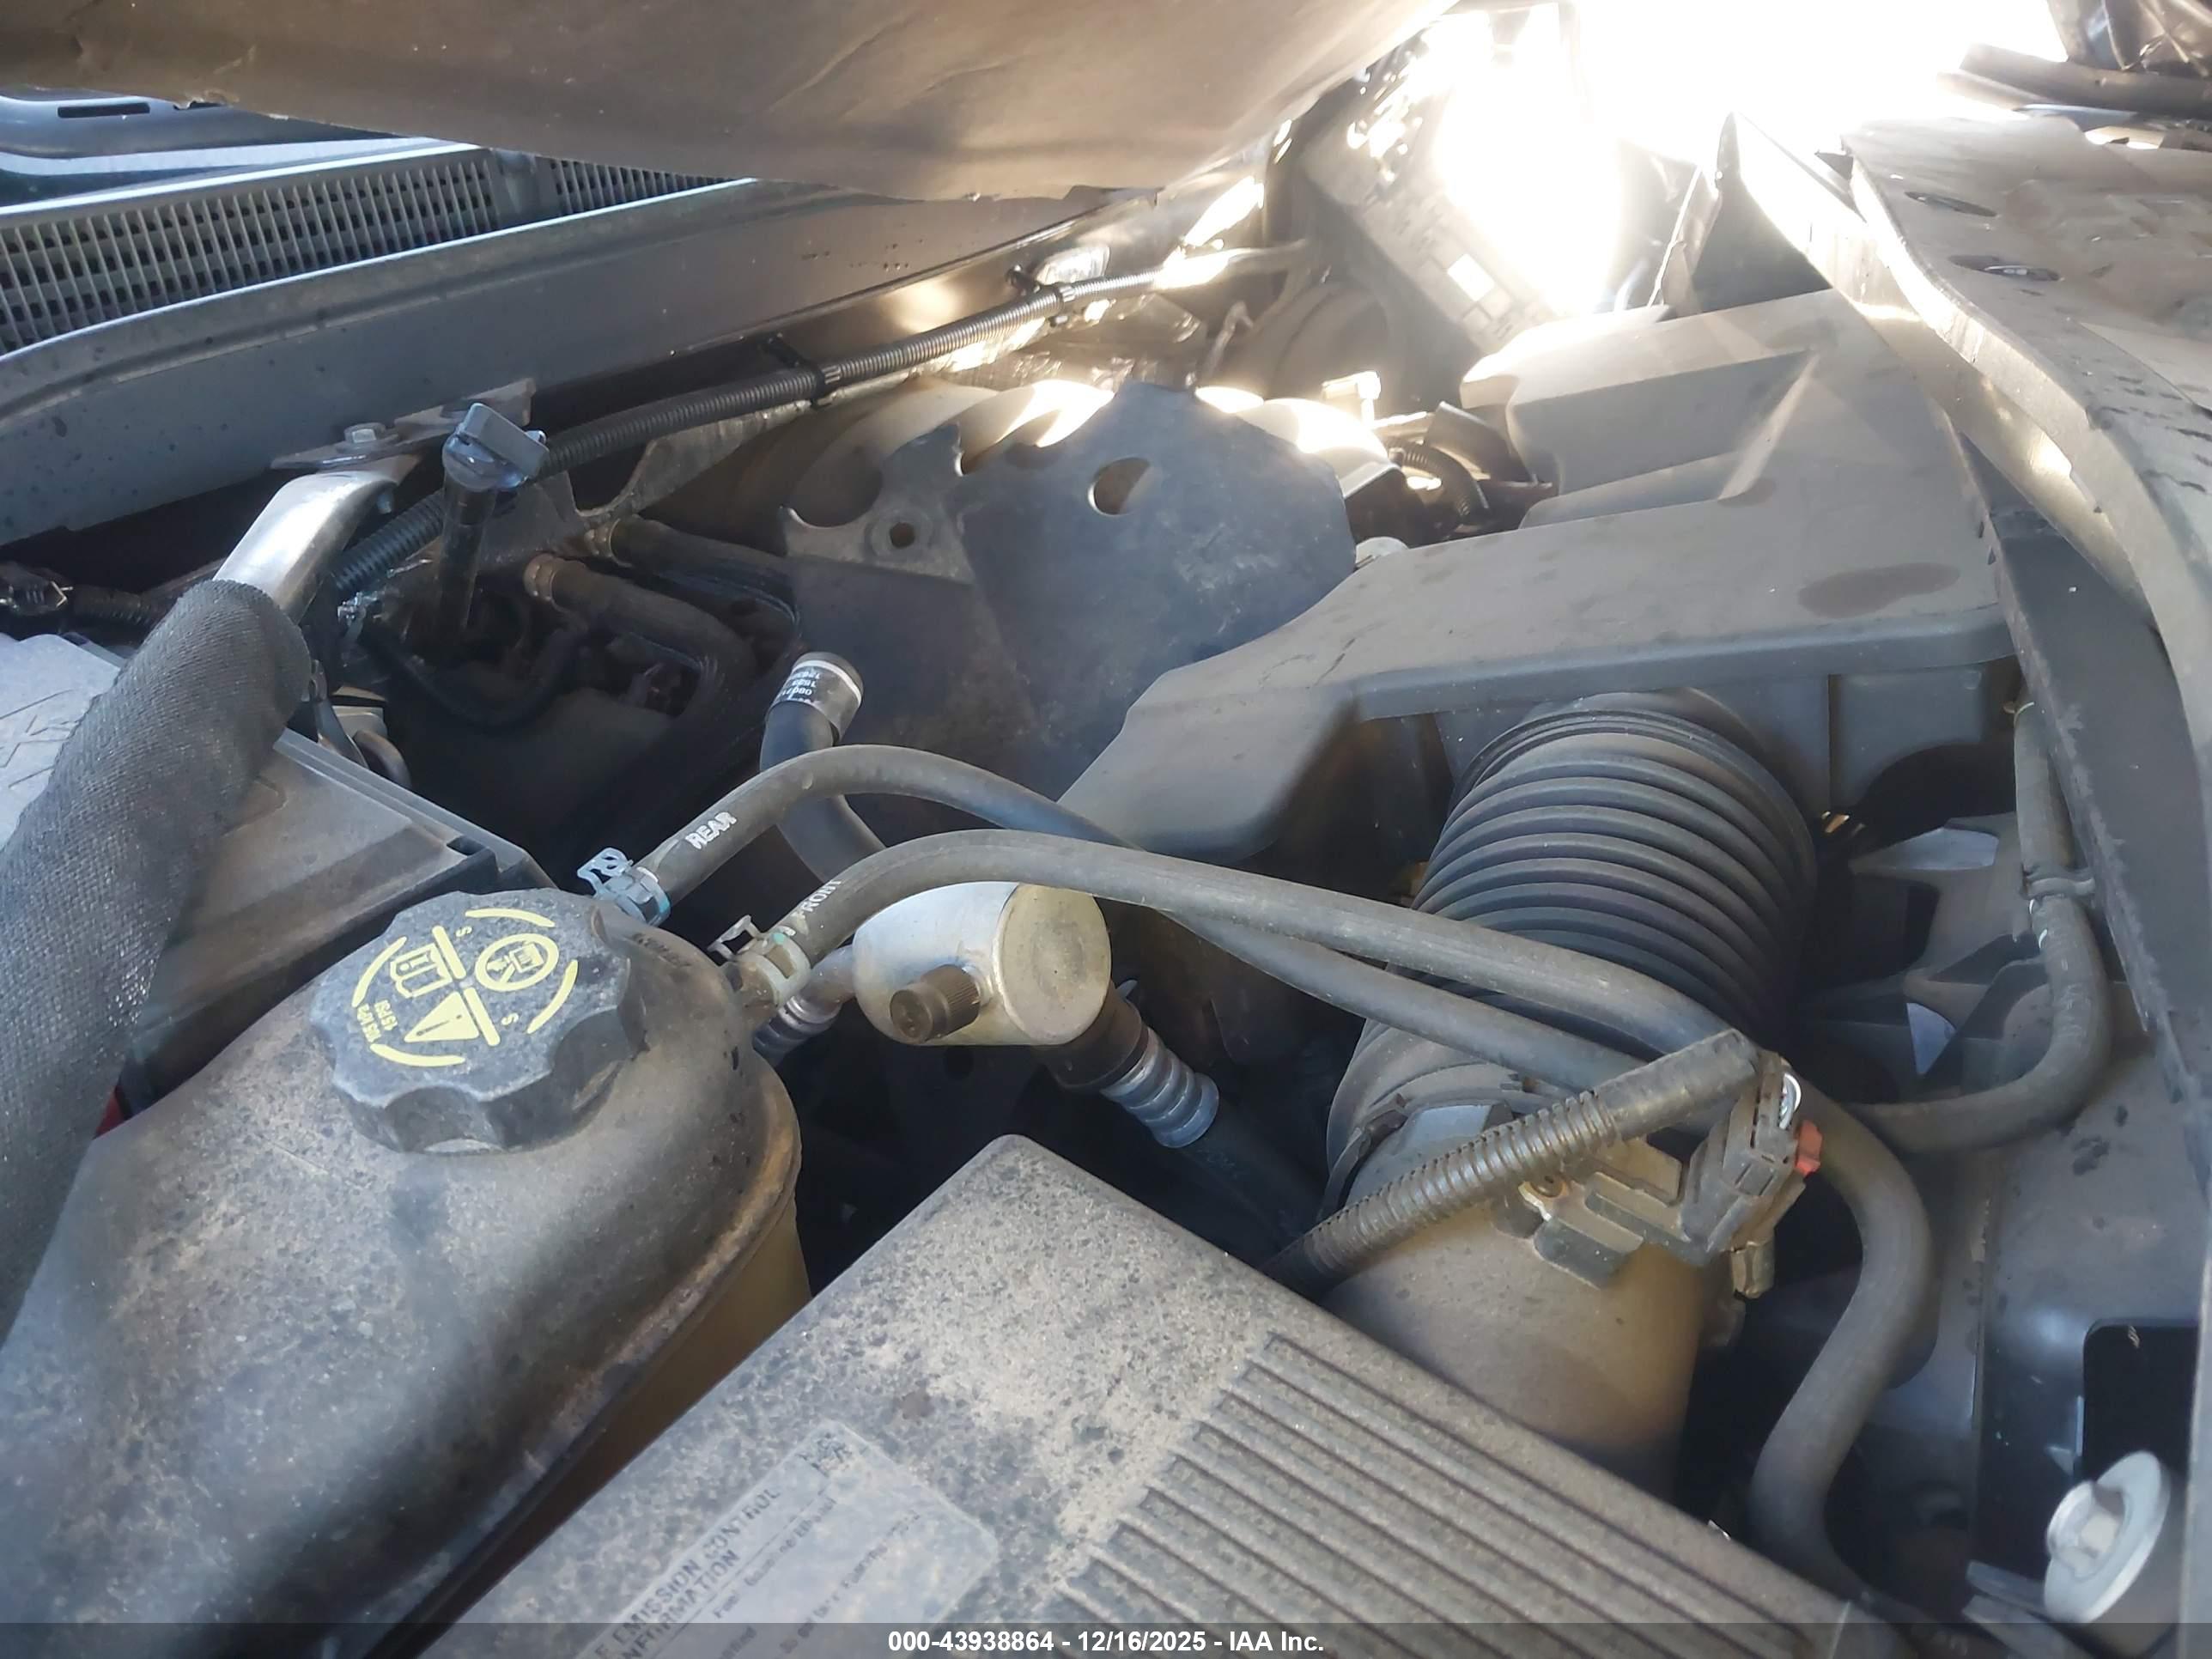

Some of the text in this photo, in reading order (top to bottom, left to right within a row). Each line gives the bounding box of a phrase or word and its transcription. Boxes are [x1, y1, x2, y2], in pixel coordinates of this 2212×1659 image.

[685, 811, 738, 850] REAR
[612, 1559, 701, 1644] EMISSION
[702, 1489, 781, 1559] CONTROL
[621, 1549, 740, 1659] NFORMATION
